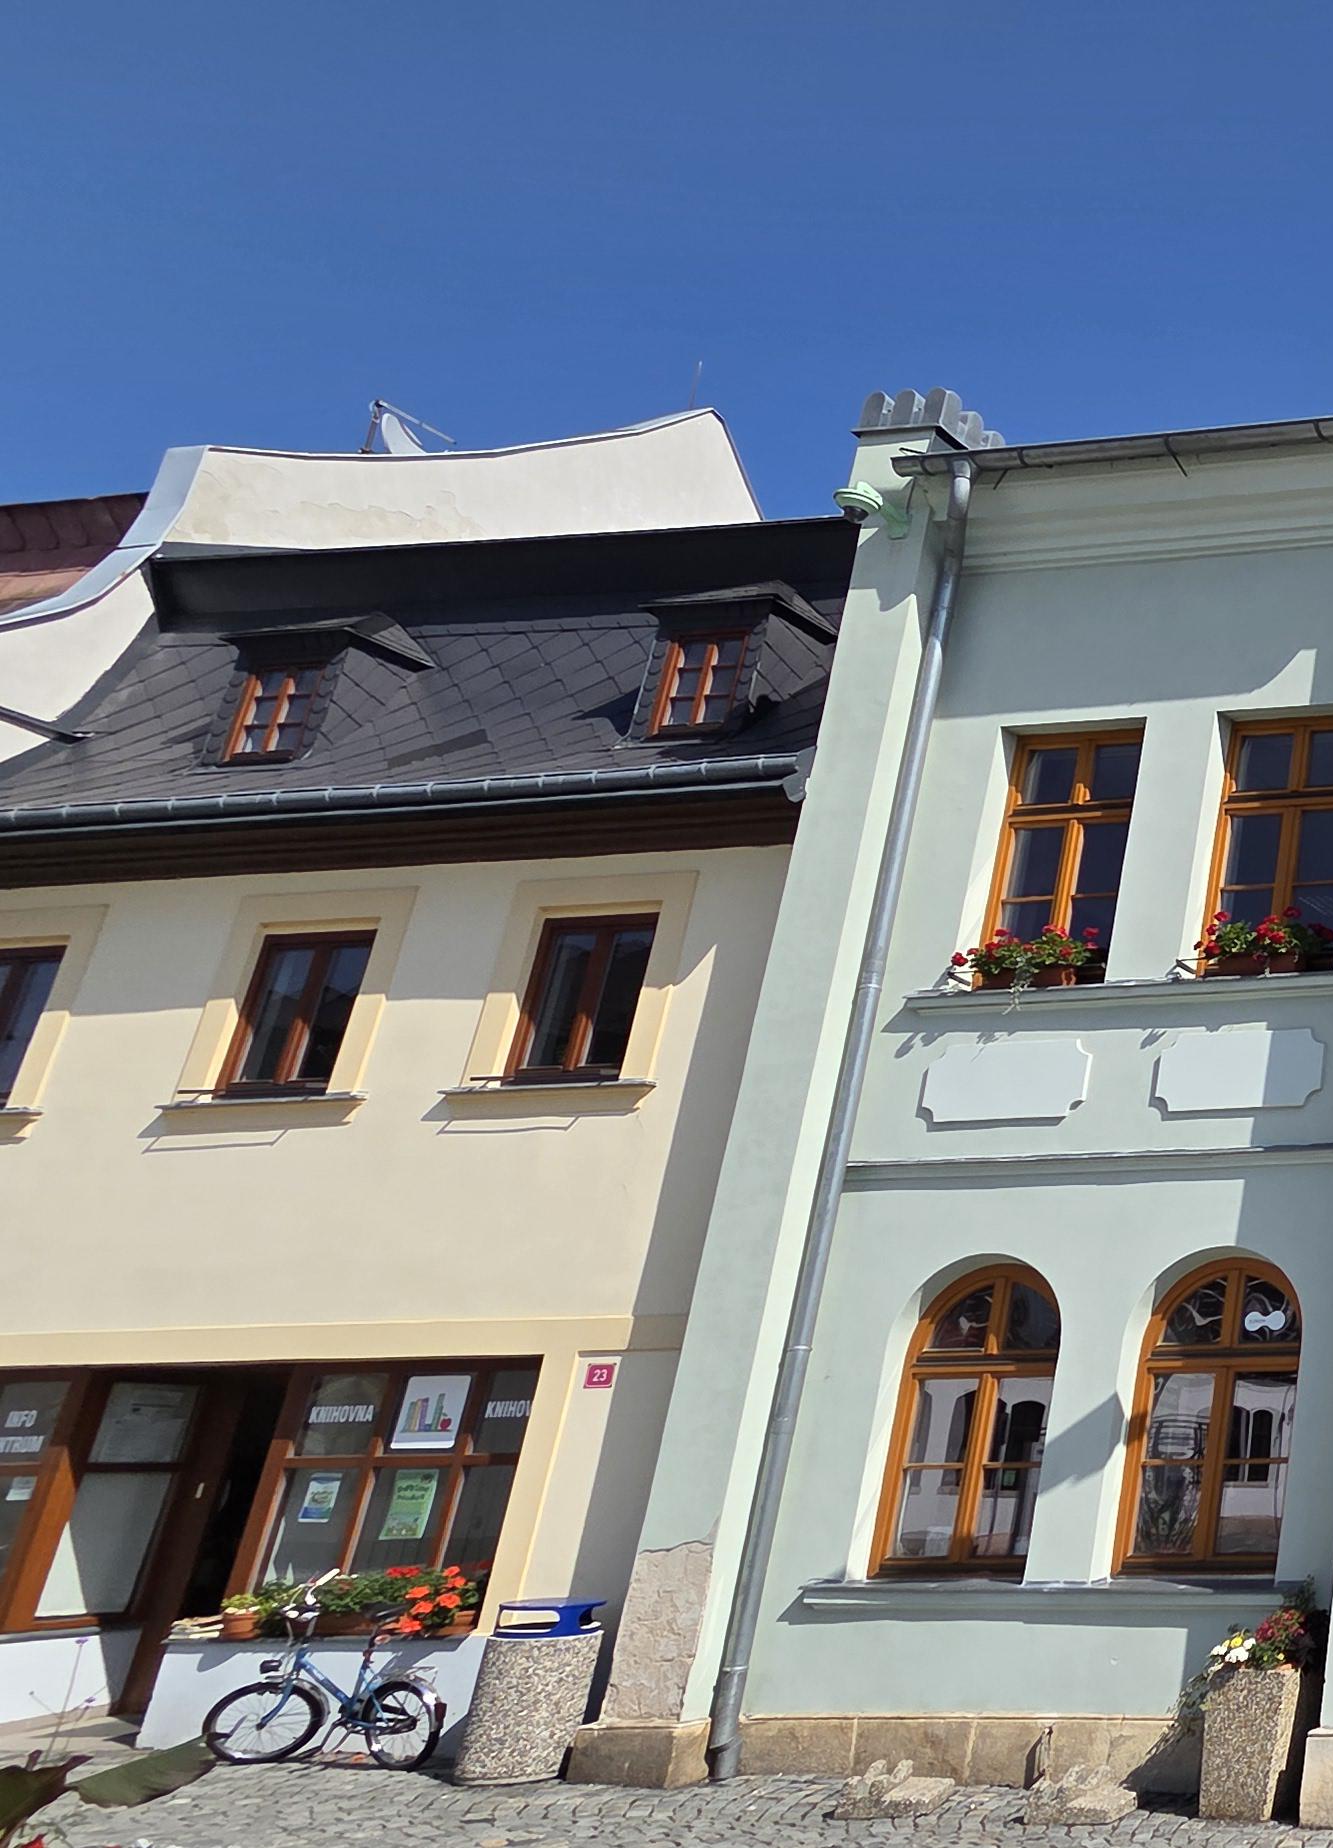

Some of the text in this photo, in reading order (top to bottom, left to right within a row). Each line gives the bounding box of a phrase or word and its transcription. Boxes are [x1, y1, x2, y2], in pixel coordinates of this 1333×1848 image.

[592, 1369, 608, 1382] 23
[4, 1410, 38, 1428] INFO
[308, 1405, 374, 1424] KNIHOVNA
